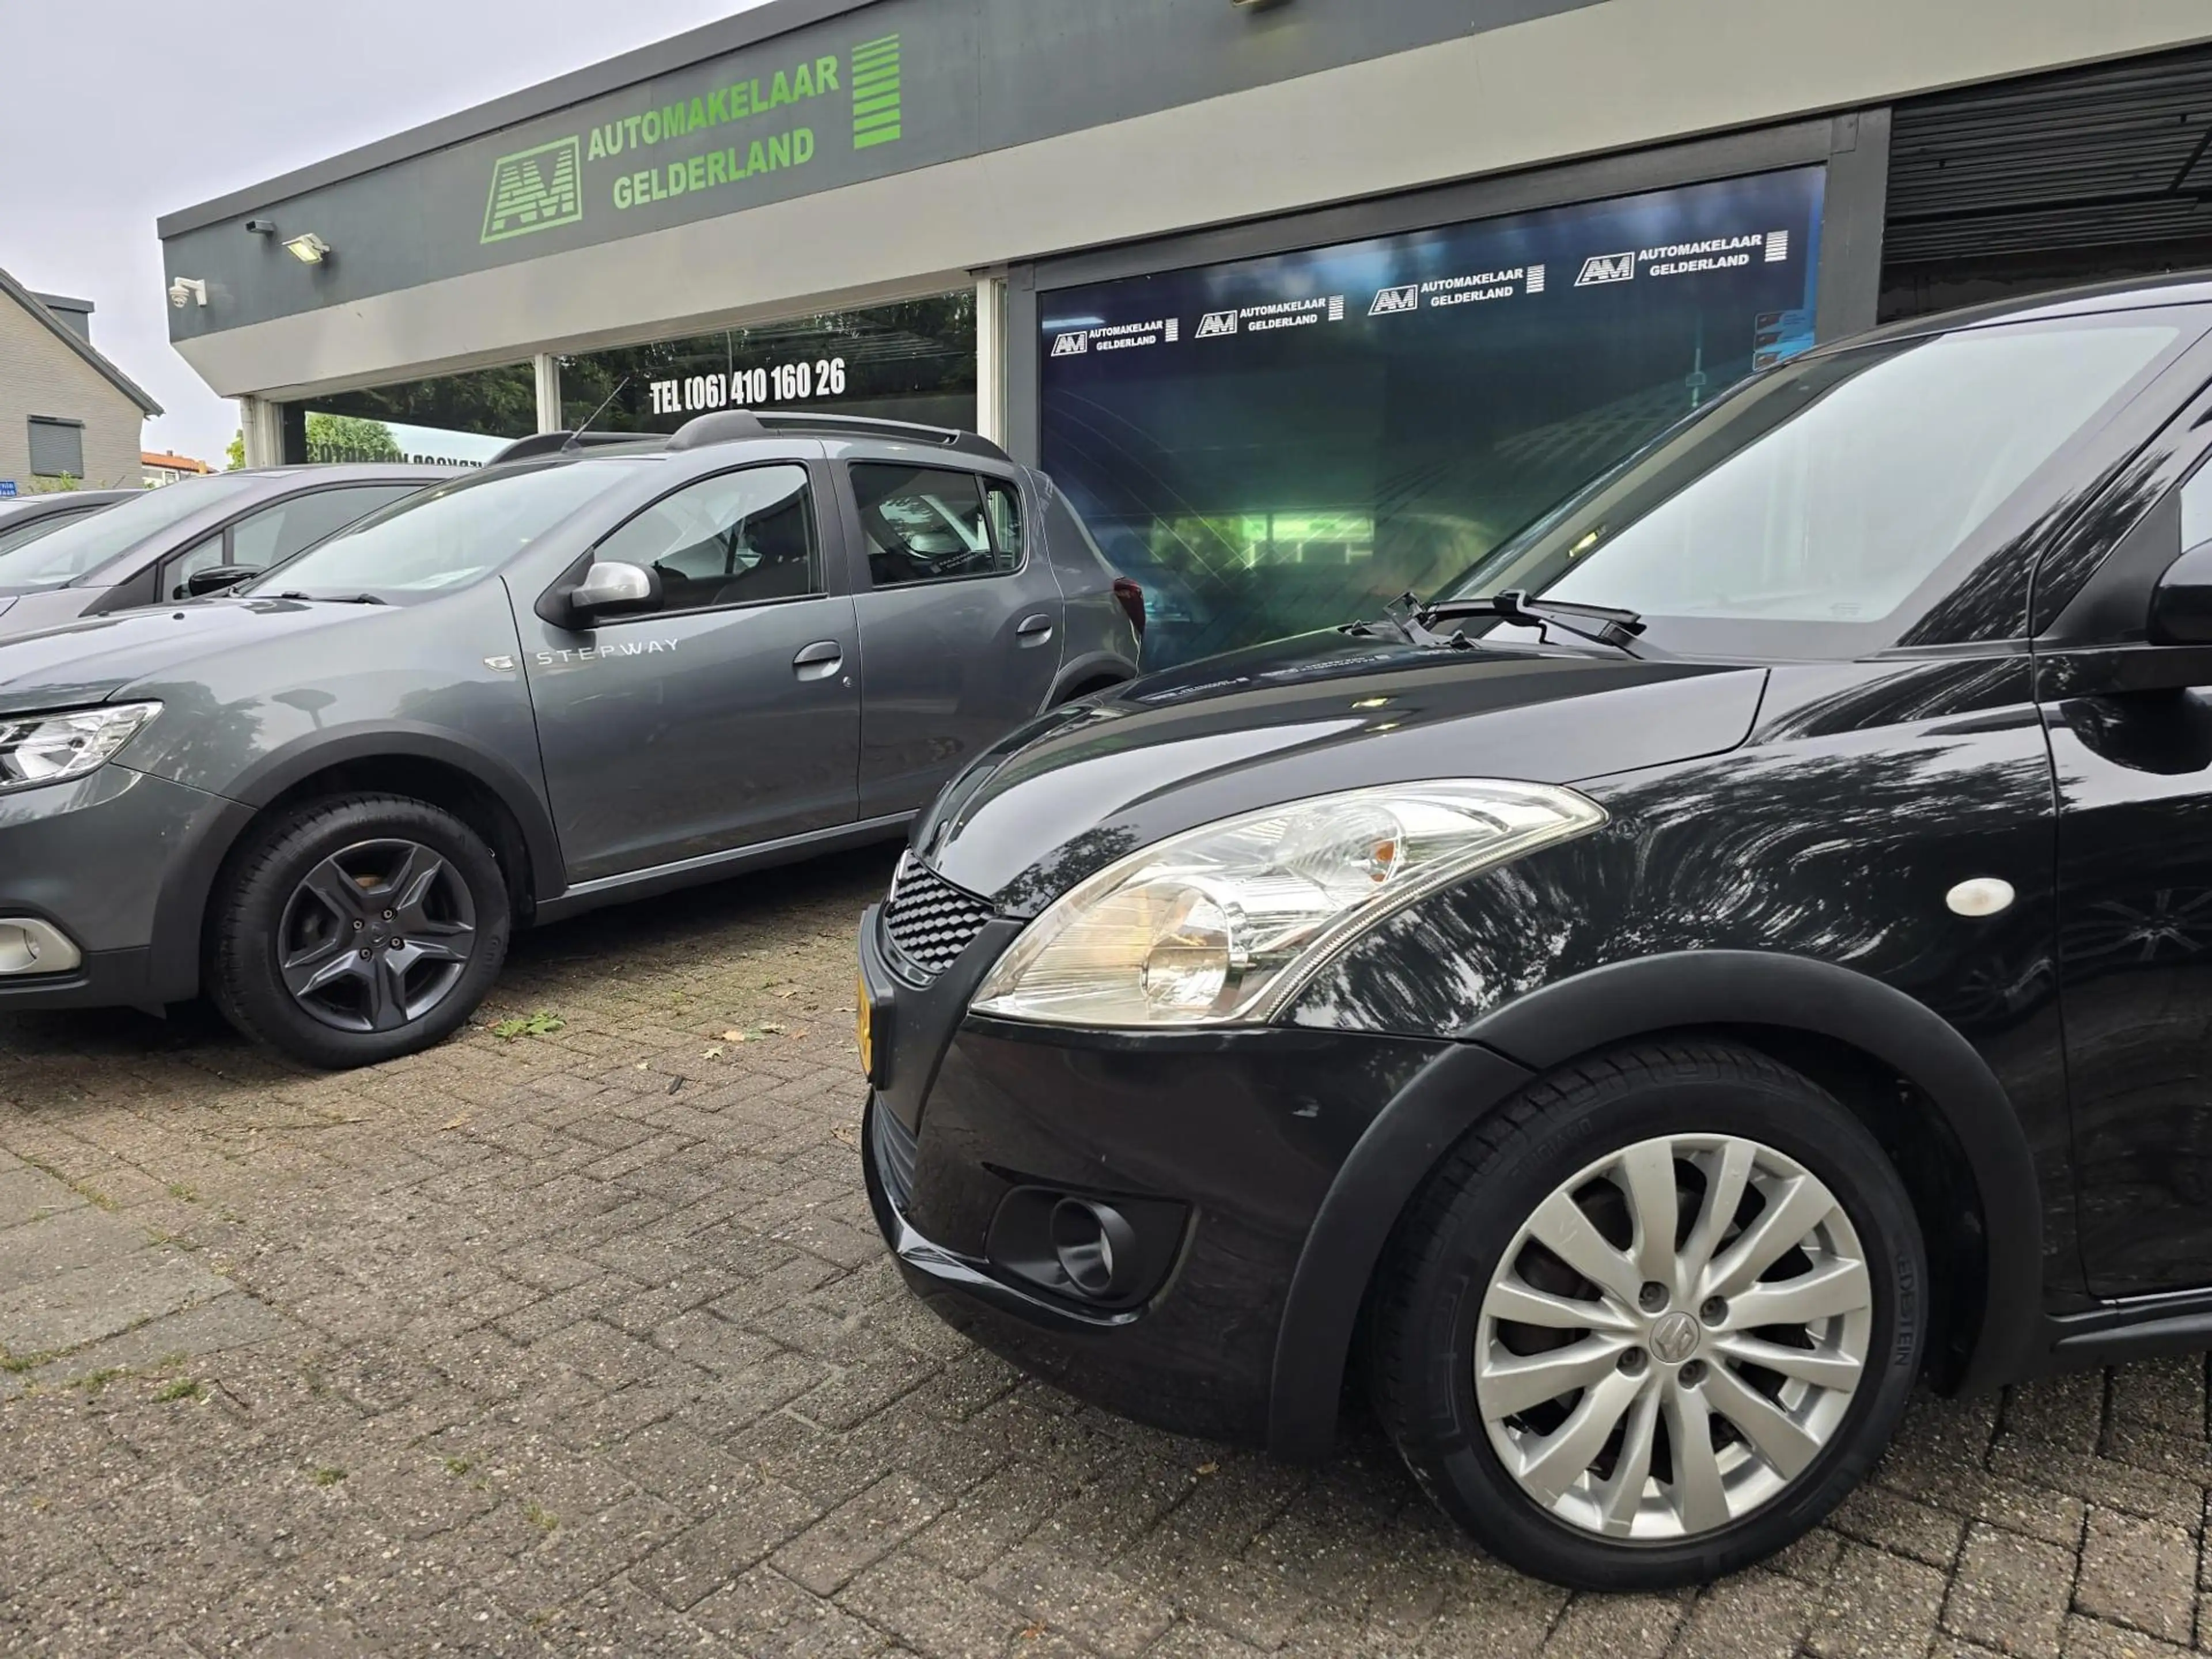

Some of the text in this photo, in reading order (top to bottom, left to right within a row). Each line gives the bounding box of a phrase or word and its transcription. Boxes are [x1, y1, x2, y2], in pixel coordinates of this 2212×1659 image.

[588, 55, 839, 161] AUTOMAKELAAR
[613, 128, 815, 209] GELDERLAND
[1638, 234, 1762, 261] AUTOMAKELAAR
[1650, 254, 1749, 276] GELDERLAND
[1421, 268, 1522, 293] AUTOMAKELAAR
[1240, 297, 1325, 318] AUTOMAKELAAR
[1431, 287, 1513, 306] GELDERLAND
[1089, 320, 1162, 338] AUTOMAKELAAR
[1249, 315, 1317, 331] GELDERLAND
[1097, 335, 1156, 350] GELDERLAND
[650, 358, 845, 414] TEL (06) 410 160 26
[537, 638, 679, 665] STEPWAY
